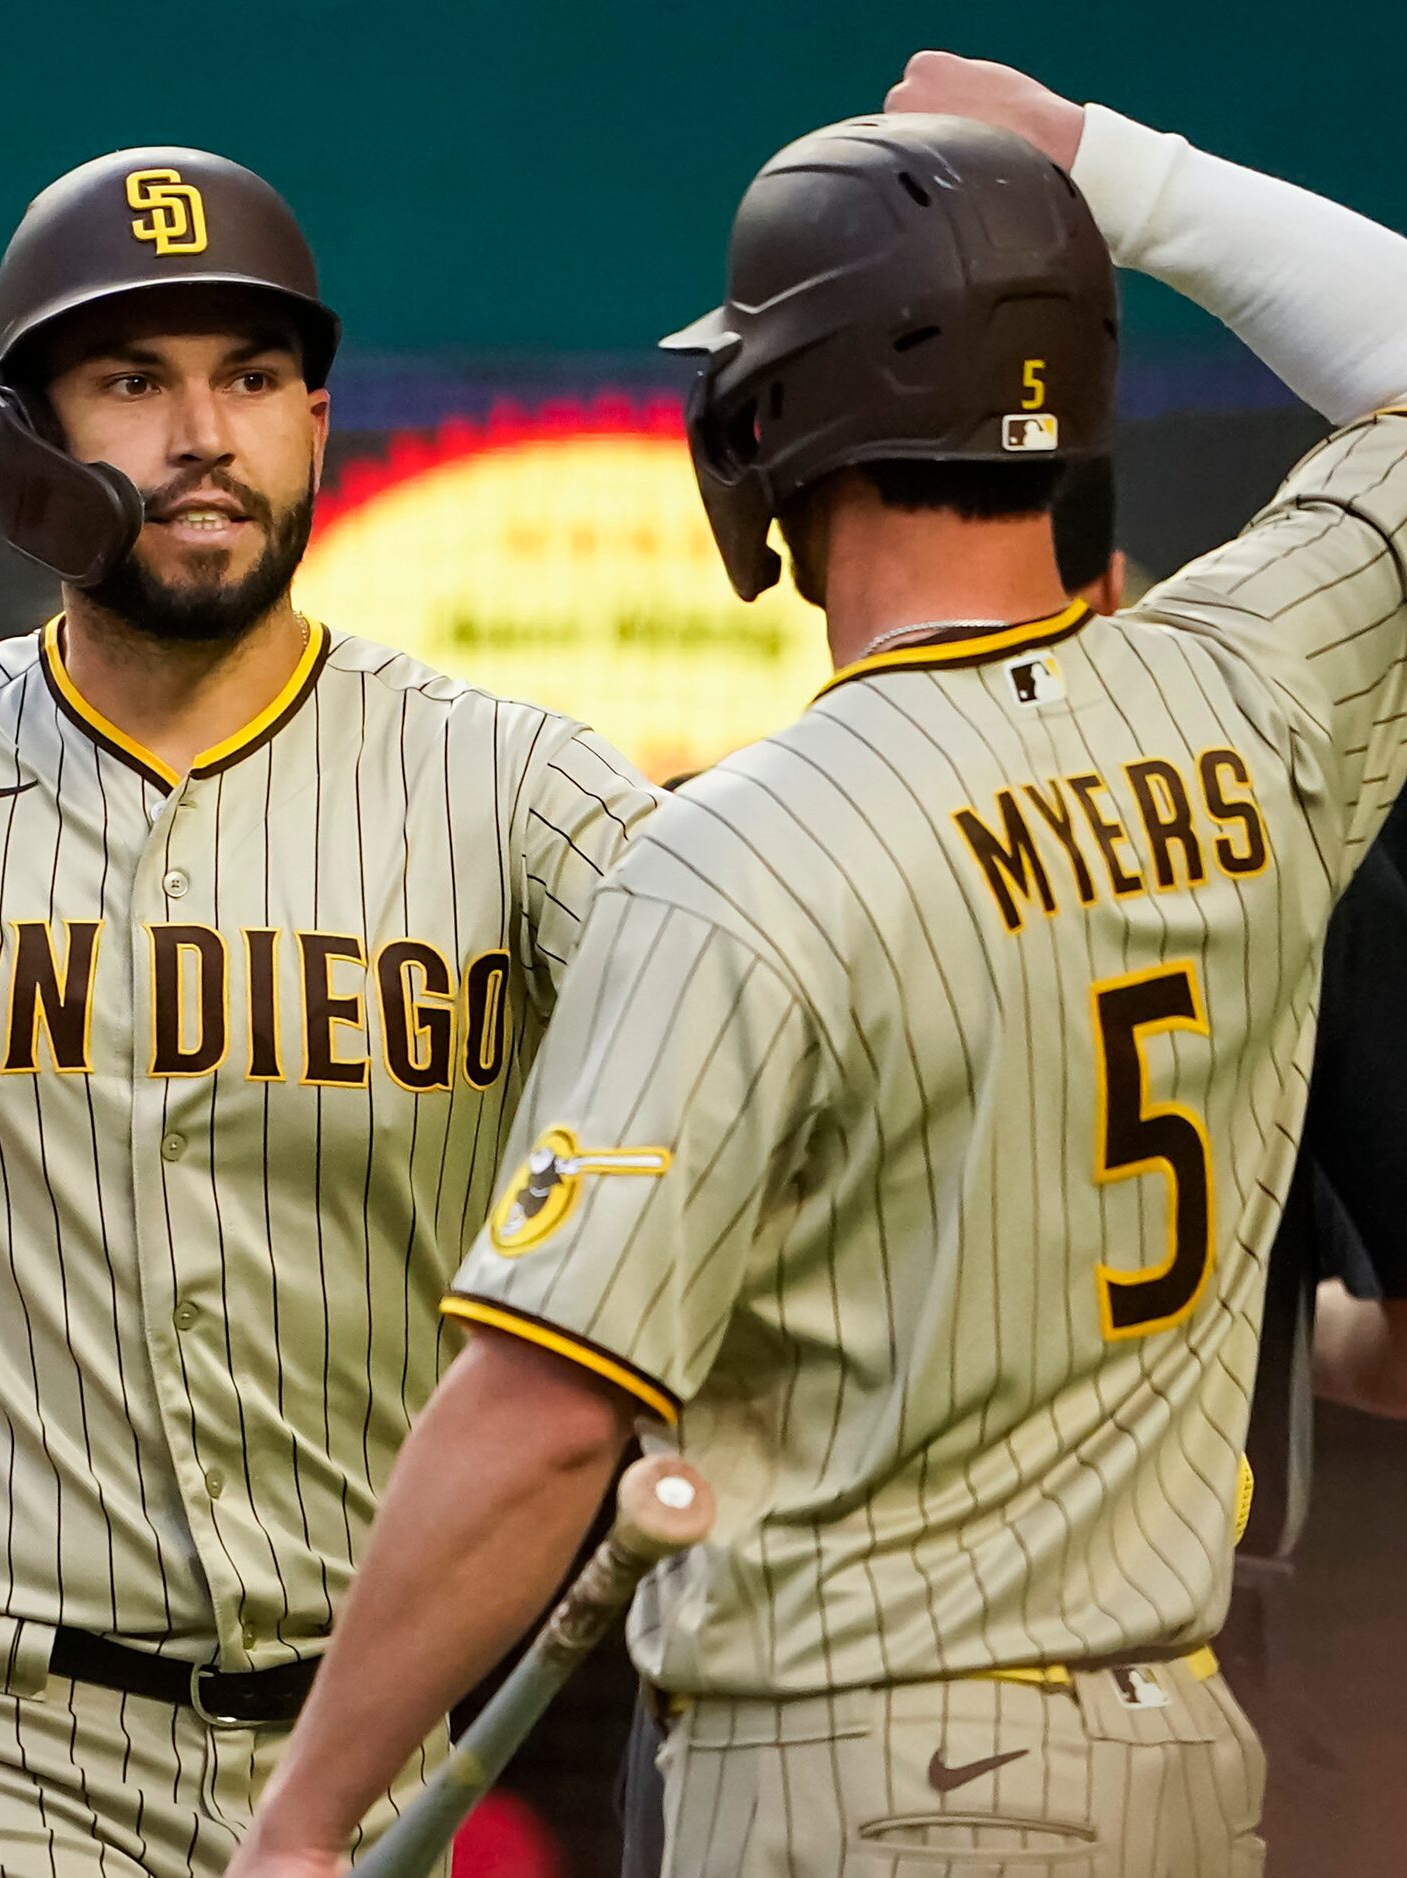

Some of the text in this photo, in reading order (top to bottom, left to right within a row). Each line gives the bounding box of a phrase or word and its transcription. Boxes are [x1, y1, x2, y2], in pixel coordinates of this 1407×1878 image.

[125, 168, 208, 256] SD
[1020, 358, 1046, 410] 5
[950, 747, 1269, 936] MYERS
[140, 921, 510, 1092] DIEGO
[1090, 958, 1215, 1342] 5
